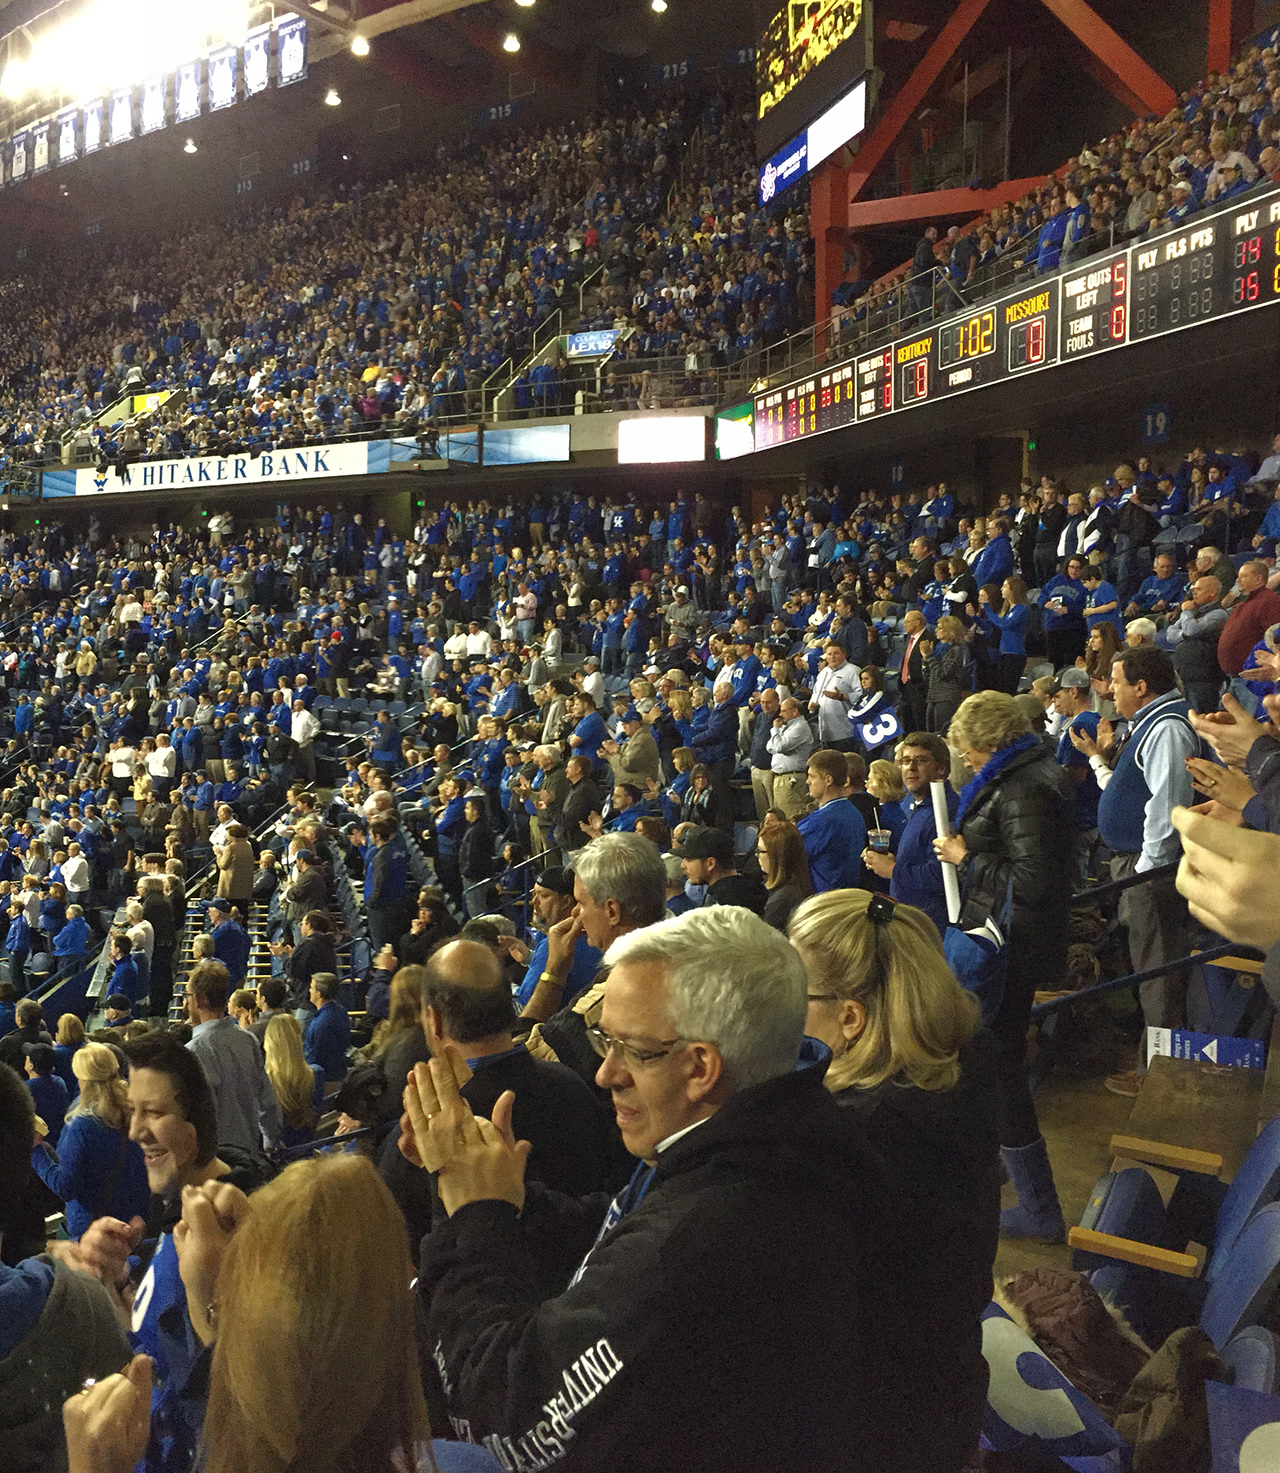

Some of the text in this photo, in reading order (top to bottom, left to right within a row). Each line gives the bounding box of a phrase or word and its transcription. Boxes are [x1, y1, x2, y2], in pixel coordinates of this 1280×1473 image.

[663, 61, 687, 79] 215
[490, 103, 512, 120] 215
[1236, 209, 1260, 236] PLY
[1138, 227, 1214, 271] PLY FLS PTS
[1241, 236, 1261, 265] 14
[1113, 262, 1126, 297] 5
[1240, 270, 1259, 301] 15
[1005, 291, 1050, 324] MISSOURI
[1076, 289, 1099, 311] LEFT
[958, 313, 994, 358] 1:02
[1069, 305, 1125, 339] TEAM 0
[897, 337, 933, 364] KENTUCKY
[1028, 320, 1043, 362] 0
[1066, 332, 1094, 353] FOULS
[916, 361, 928, 397] 0
[1145, 411, 1167, 437] 19
[260, 449, 331, 476] BANK
